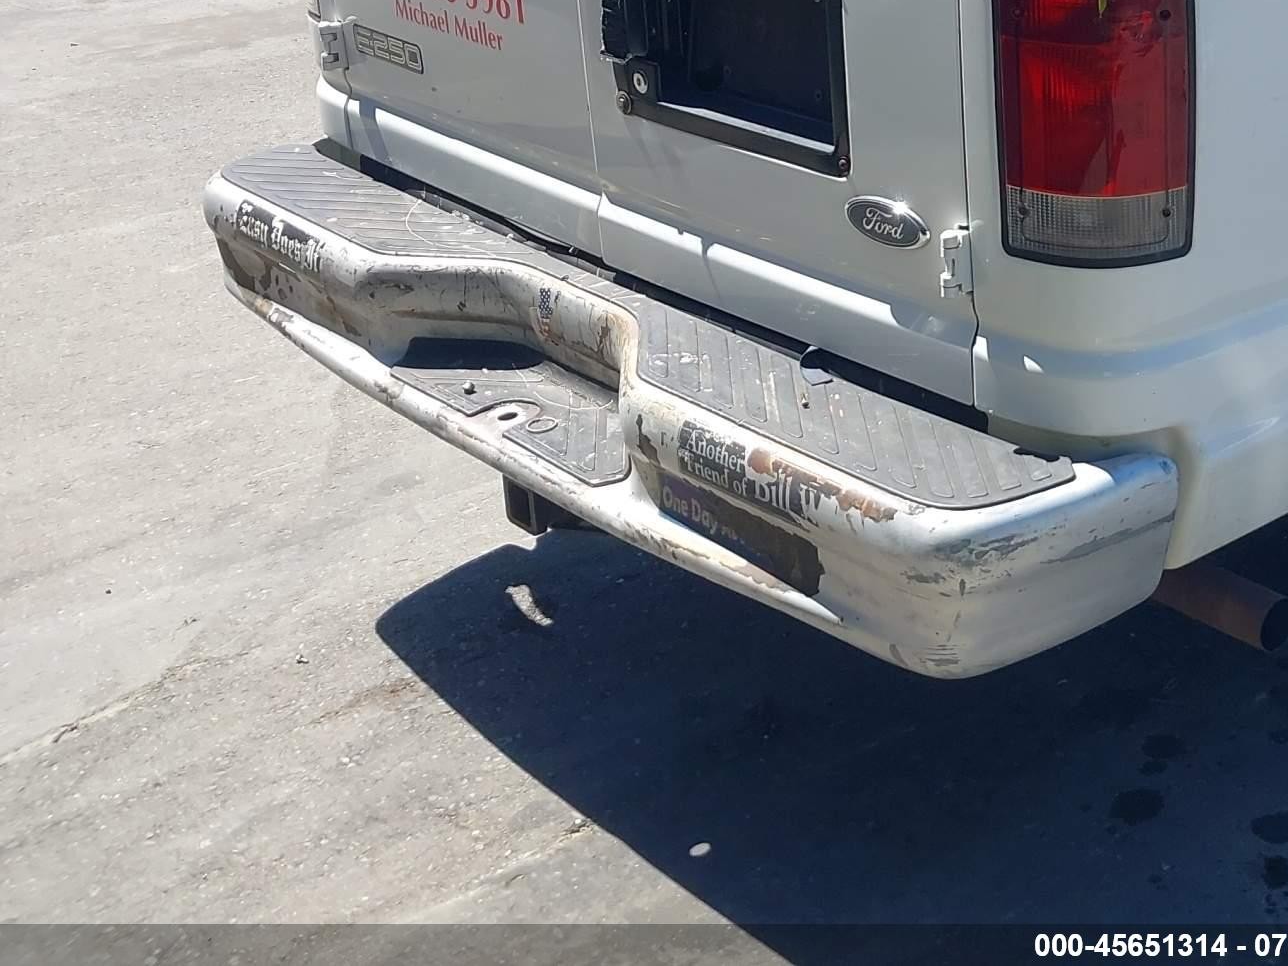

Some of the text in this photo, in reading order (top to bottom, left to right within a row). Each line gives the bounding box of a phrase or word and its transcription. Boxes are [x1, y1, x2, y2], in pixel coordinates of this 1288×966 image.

[355, 27, 422, 70] E-250
[454, 16, 503, 51] Muller
[863, 207, 904, 239] Ford
[686, 429, 745, 473] Another
[733, 477, 749, 497] of
[662, 484, 689, 517] One
[691, 497, 718, 535] Day
